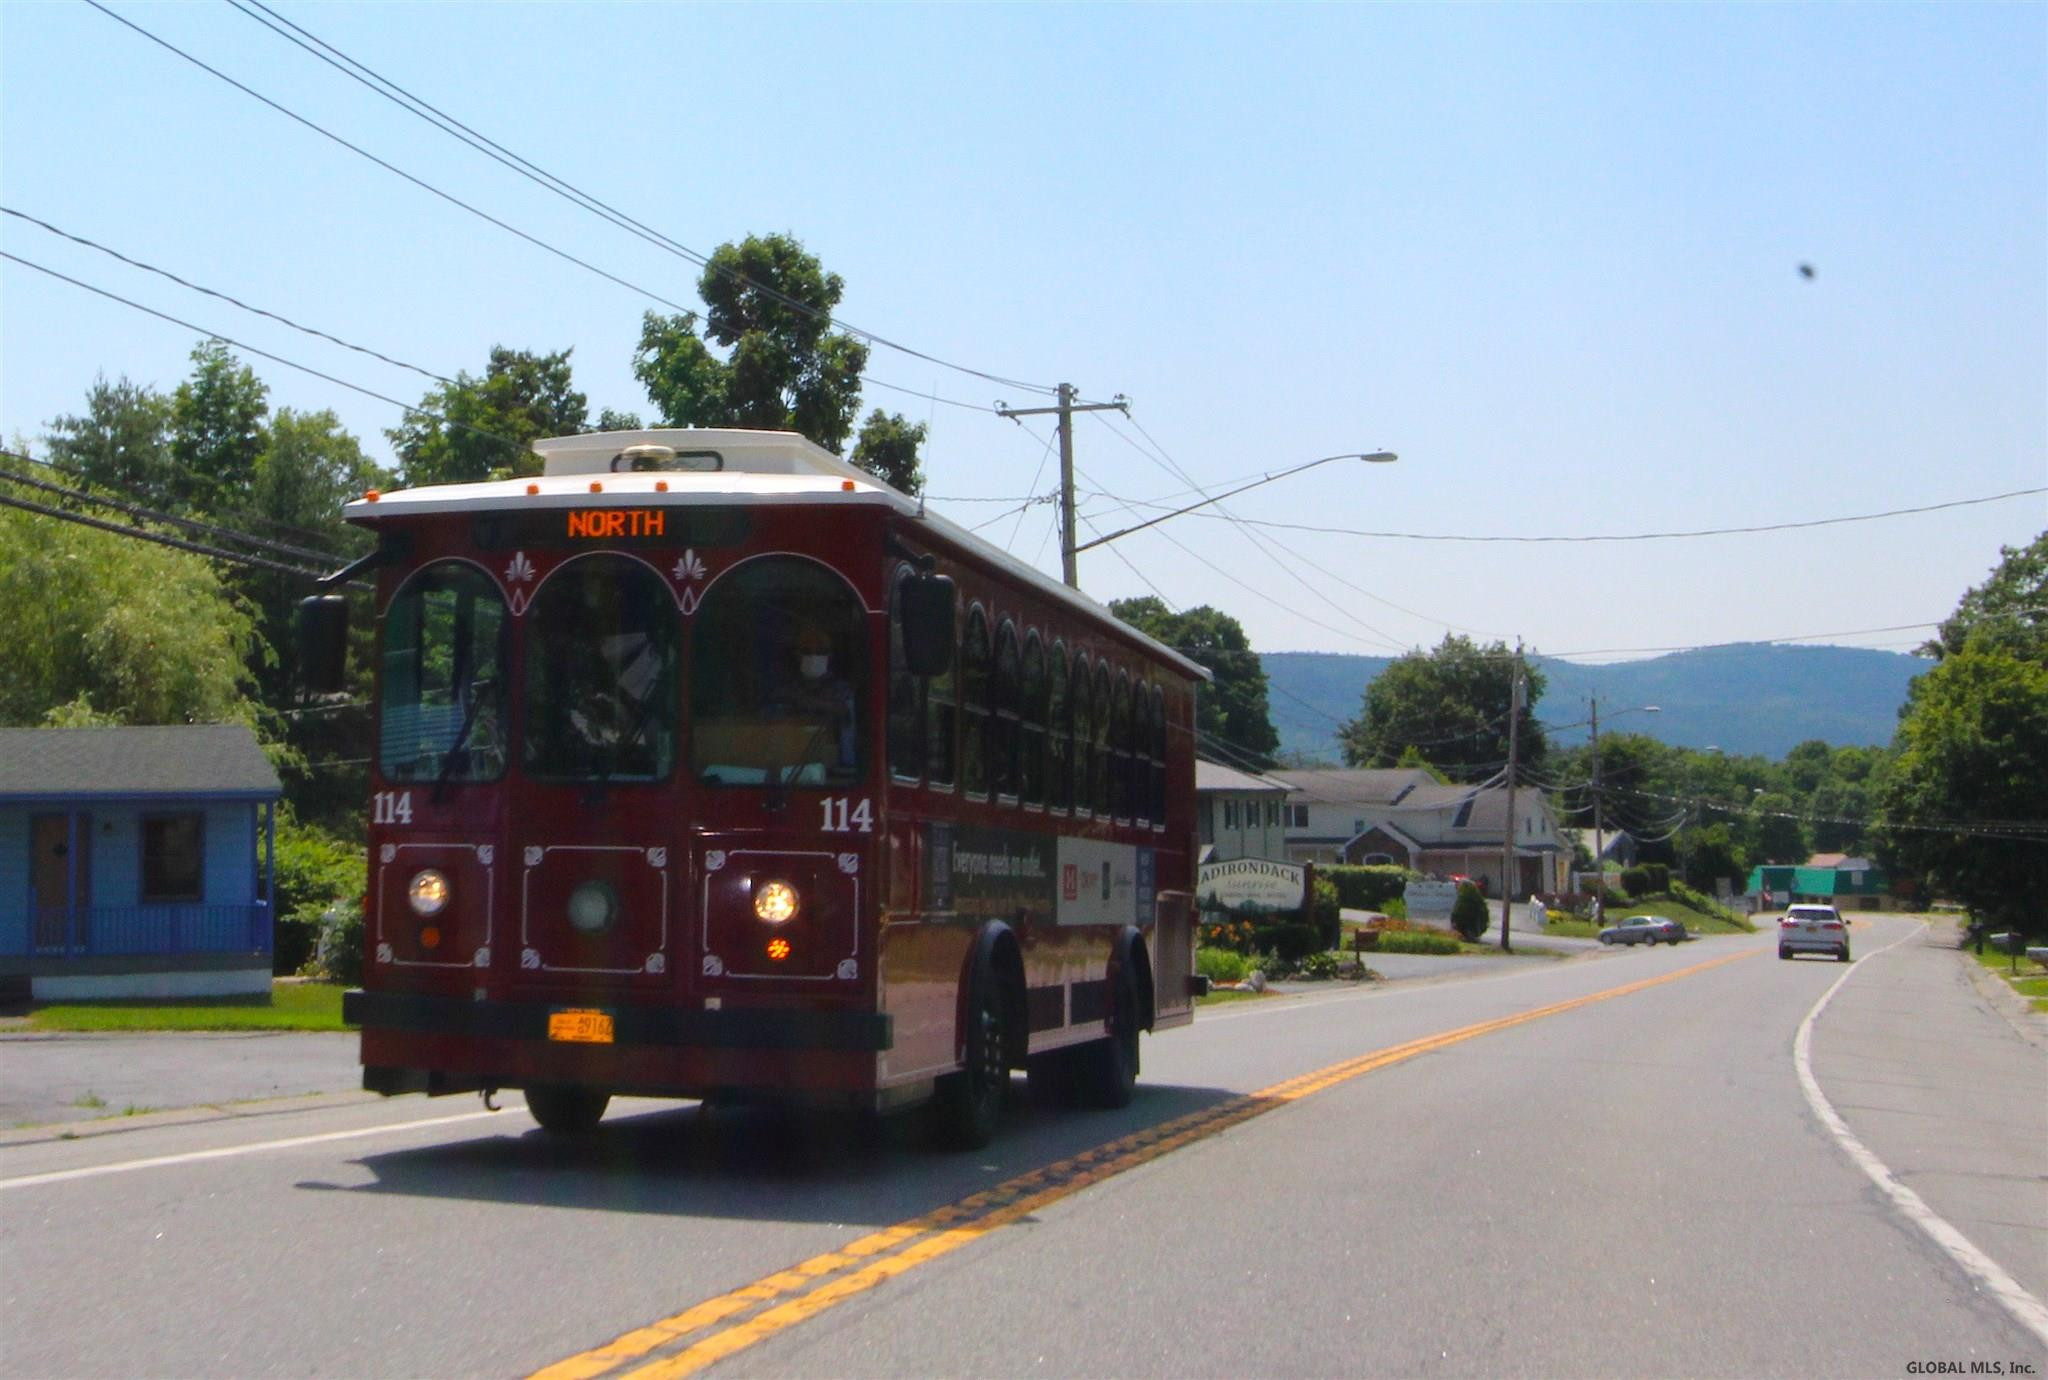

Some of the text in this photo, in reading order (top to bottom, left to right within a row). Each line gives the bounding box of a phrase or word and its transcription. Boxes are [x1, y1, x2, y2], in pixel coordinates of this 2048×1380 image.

[568, 510, 664, 537] NORTH
[373, 791, 413, 824] 114
[820, 797, 874, 832] 114
[1201, 862, 1299, 886] ADIRONDACK
